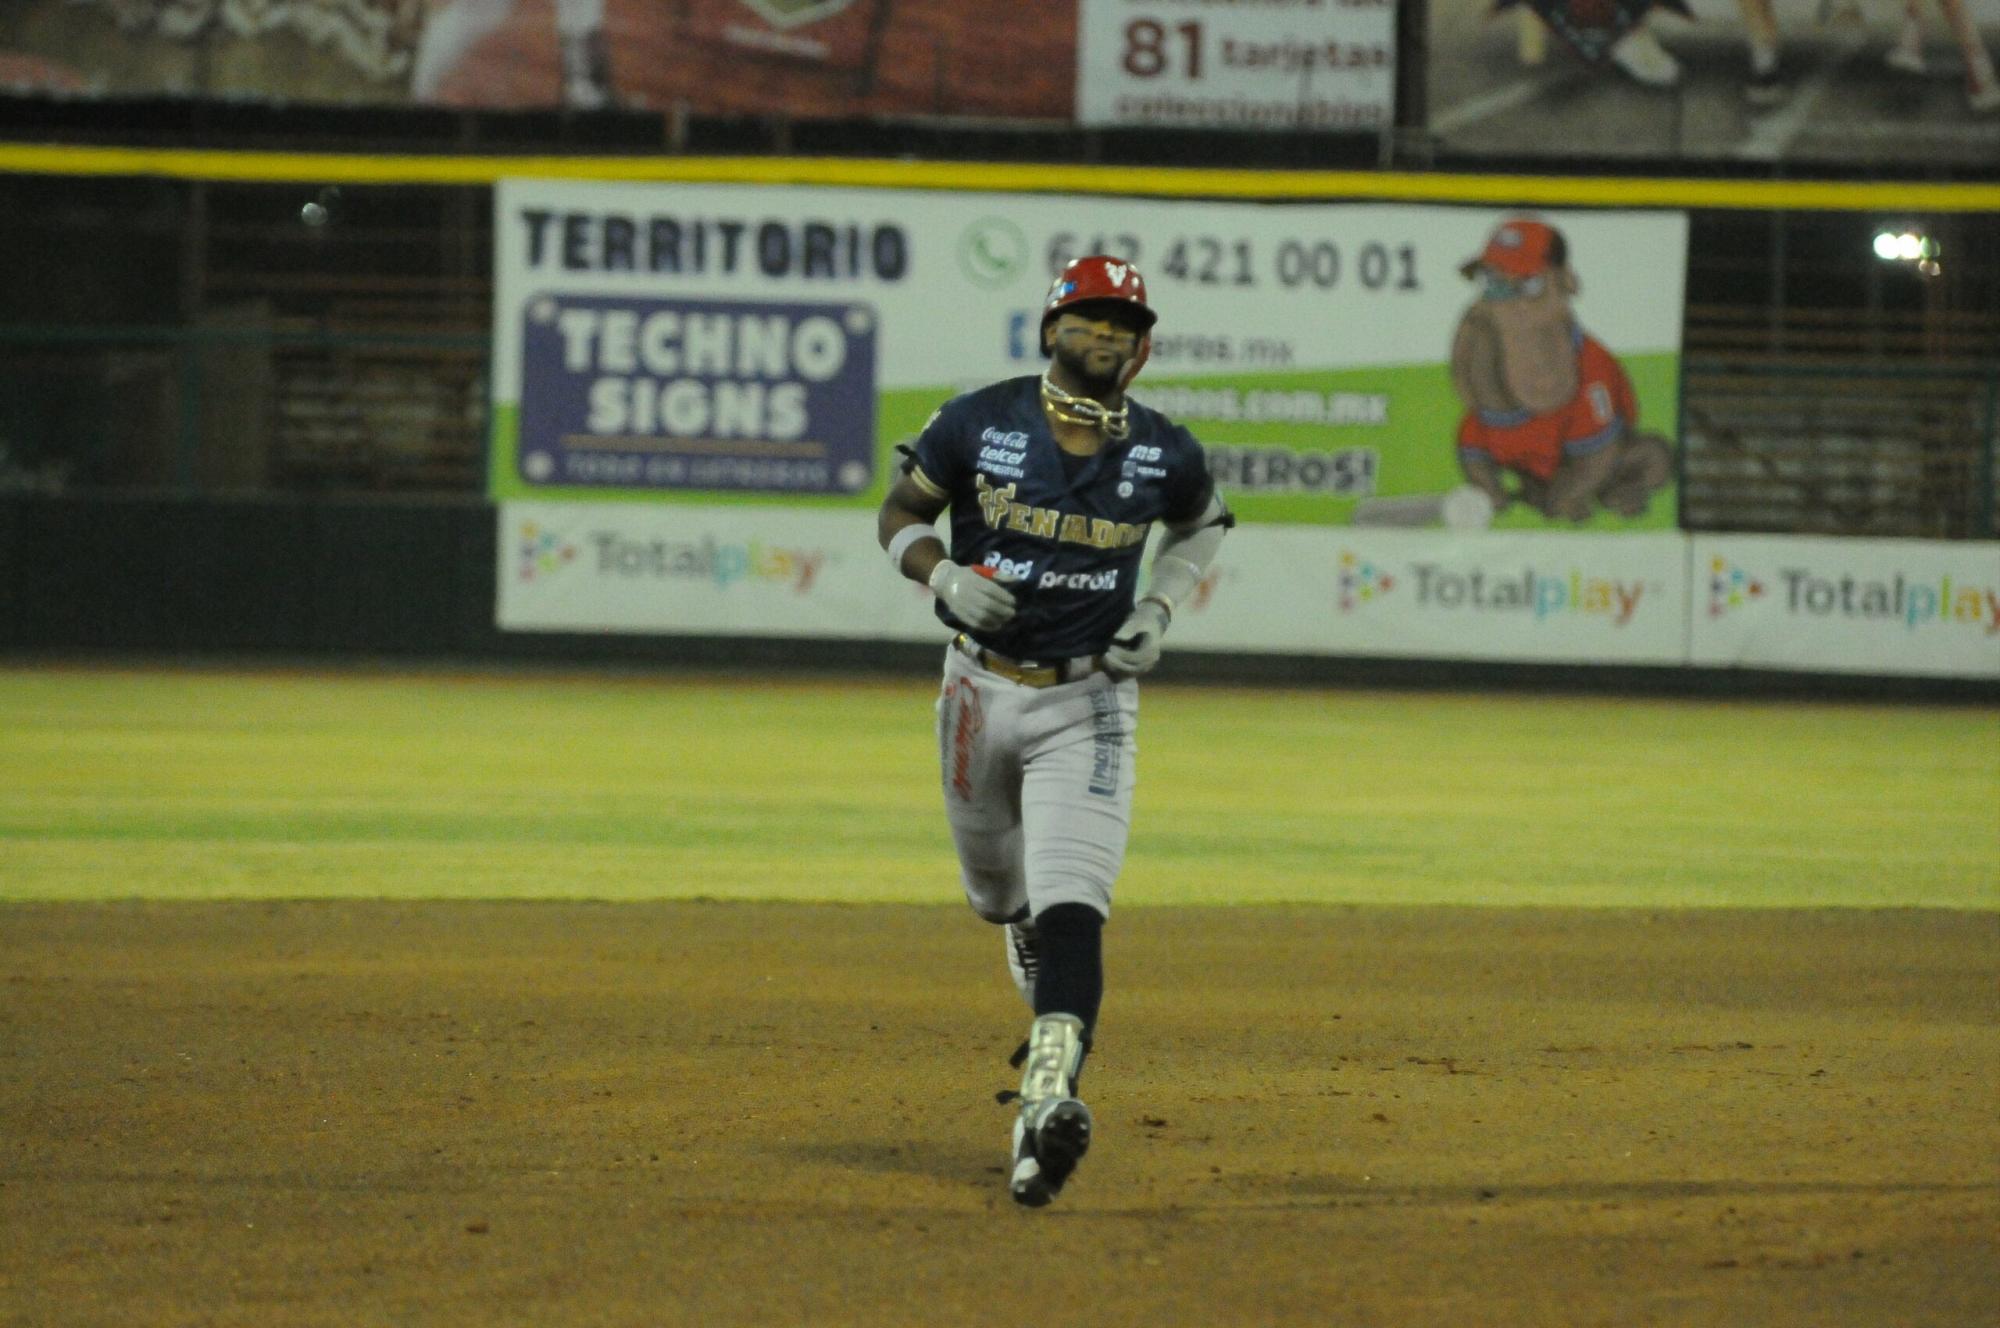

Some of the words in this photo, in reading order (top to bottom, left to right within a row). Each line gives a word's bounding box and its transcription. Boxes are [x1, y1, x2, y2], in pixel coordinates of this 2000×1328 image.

[1122, 18, 1202, 79] 81
[522, 209, 908, 281] TERRITORIO
[1163, 235, 1254, 285] 421
[1277, 239, 1340, 289] 00
[1358, 240, 1421, 291] 01
[558, 308, 847, 382] TECHNO
[587, 377, 809, 440] SIGNS
[1411, 561, 1644, 627] Totalplay
[1781, 568, 2000, 635] Totalplay
